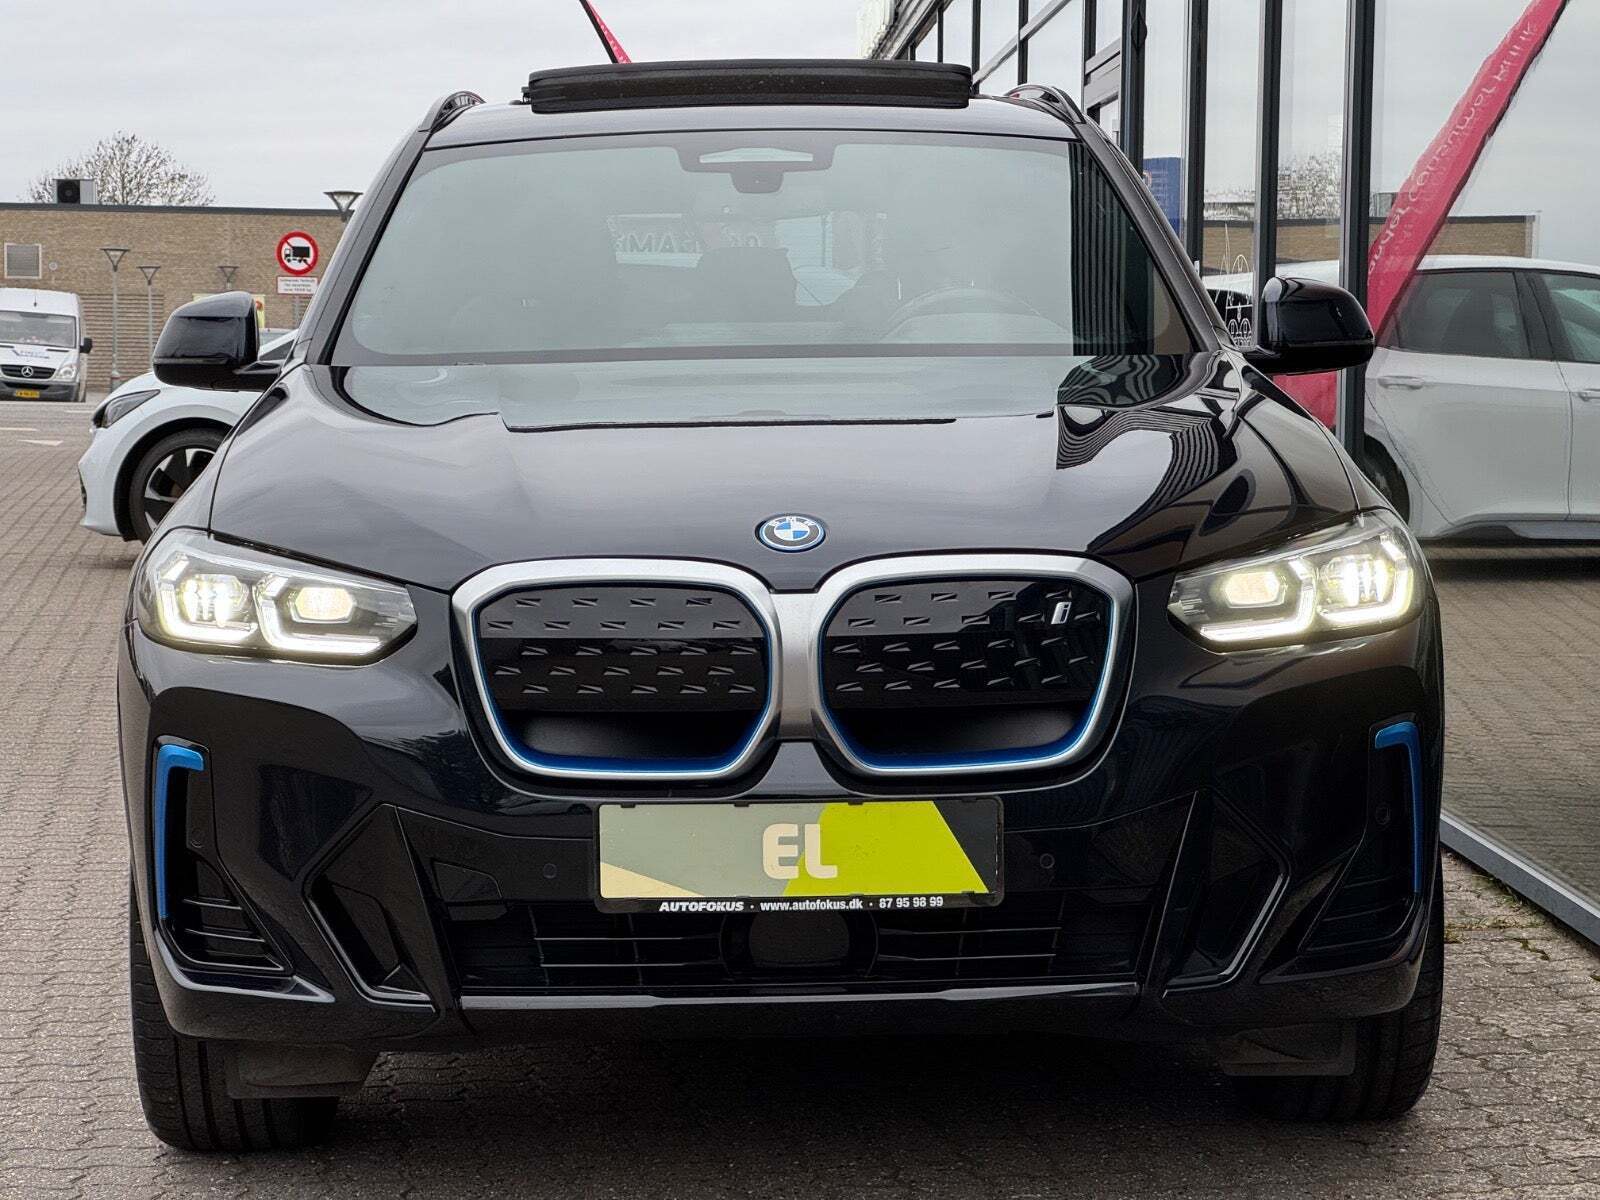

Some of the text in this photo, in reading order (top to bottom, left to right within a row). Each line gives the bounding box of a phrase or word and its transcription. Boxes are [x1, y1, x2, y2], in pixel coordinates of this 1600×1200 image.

[762, 822, 838, 880] EL
[658, 900, 745, 913] AUTOFOKUS
[760, 898, 863, 912] www.autofokus.dk
[896, 897, 910, 908] 95
[929, 896, 944, 907] 99
